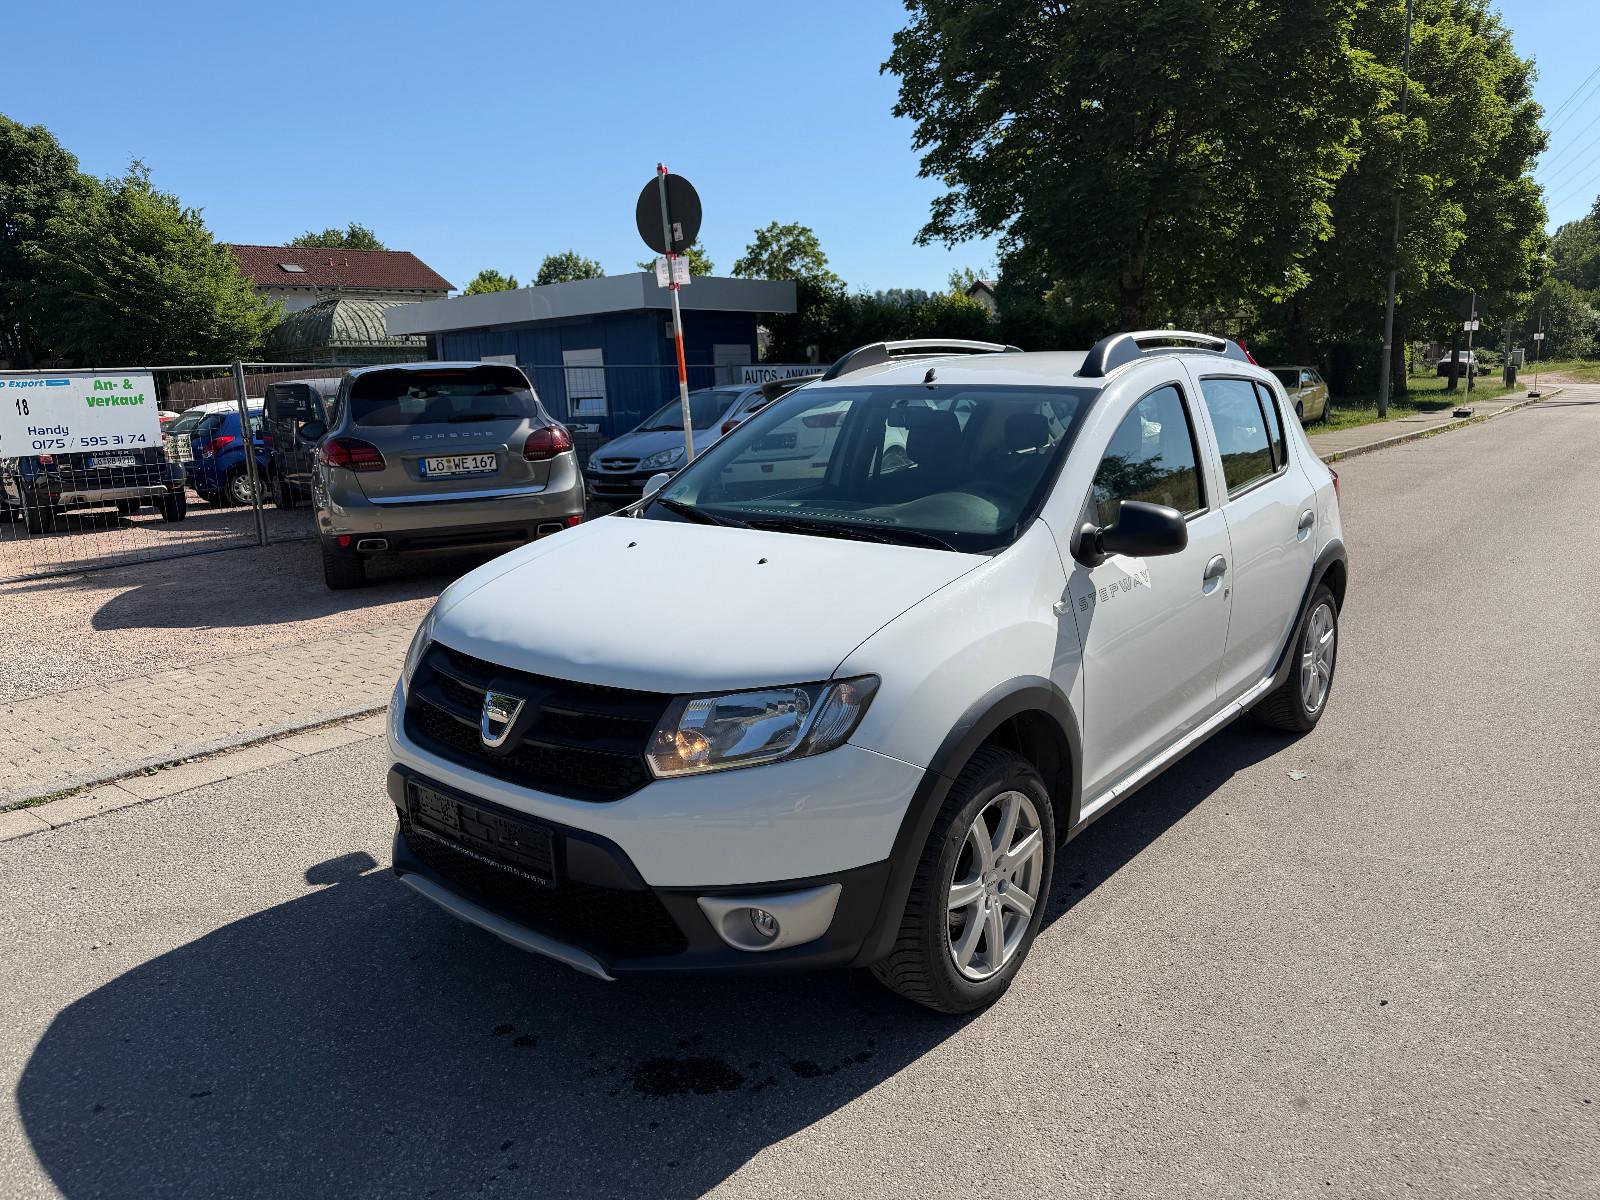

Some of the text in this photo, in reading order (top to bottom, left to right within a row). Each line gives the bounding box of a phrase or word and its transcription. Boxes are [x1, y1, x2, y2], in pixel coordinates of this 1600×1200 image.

[9, 380, 45, 388] Export
[744, 369, 778, 384] AUTOS
[93, 378, 134, 391] An- &
[15, 398, 30, 416] 18
[85, 393, 145, 408] Verkauf
[27, 425, 70, 437] Handy
[412, 431, 494, 441] PORSCHE
[32, 438, 66, 450] 0175
[80, 436, 109, 447] 595
[111, 435, 124, 445] 31
[127, 433, 147, 444] 74
[426, 459, 445, 472] LÖ
[453, 457, 470, 470] WE
[472, 455, 495, 469] 167
[1079, 568, 1150, 612] STEPWAY
